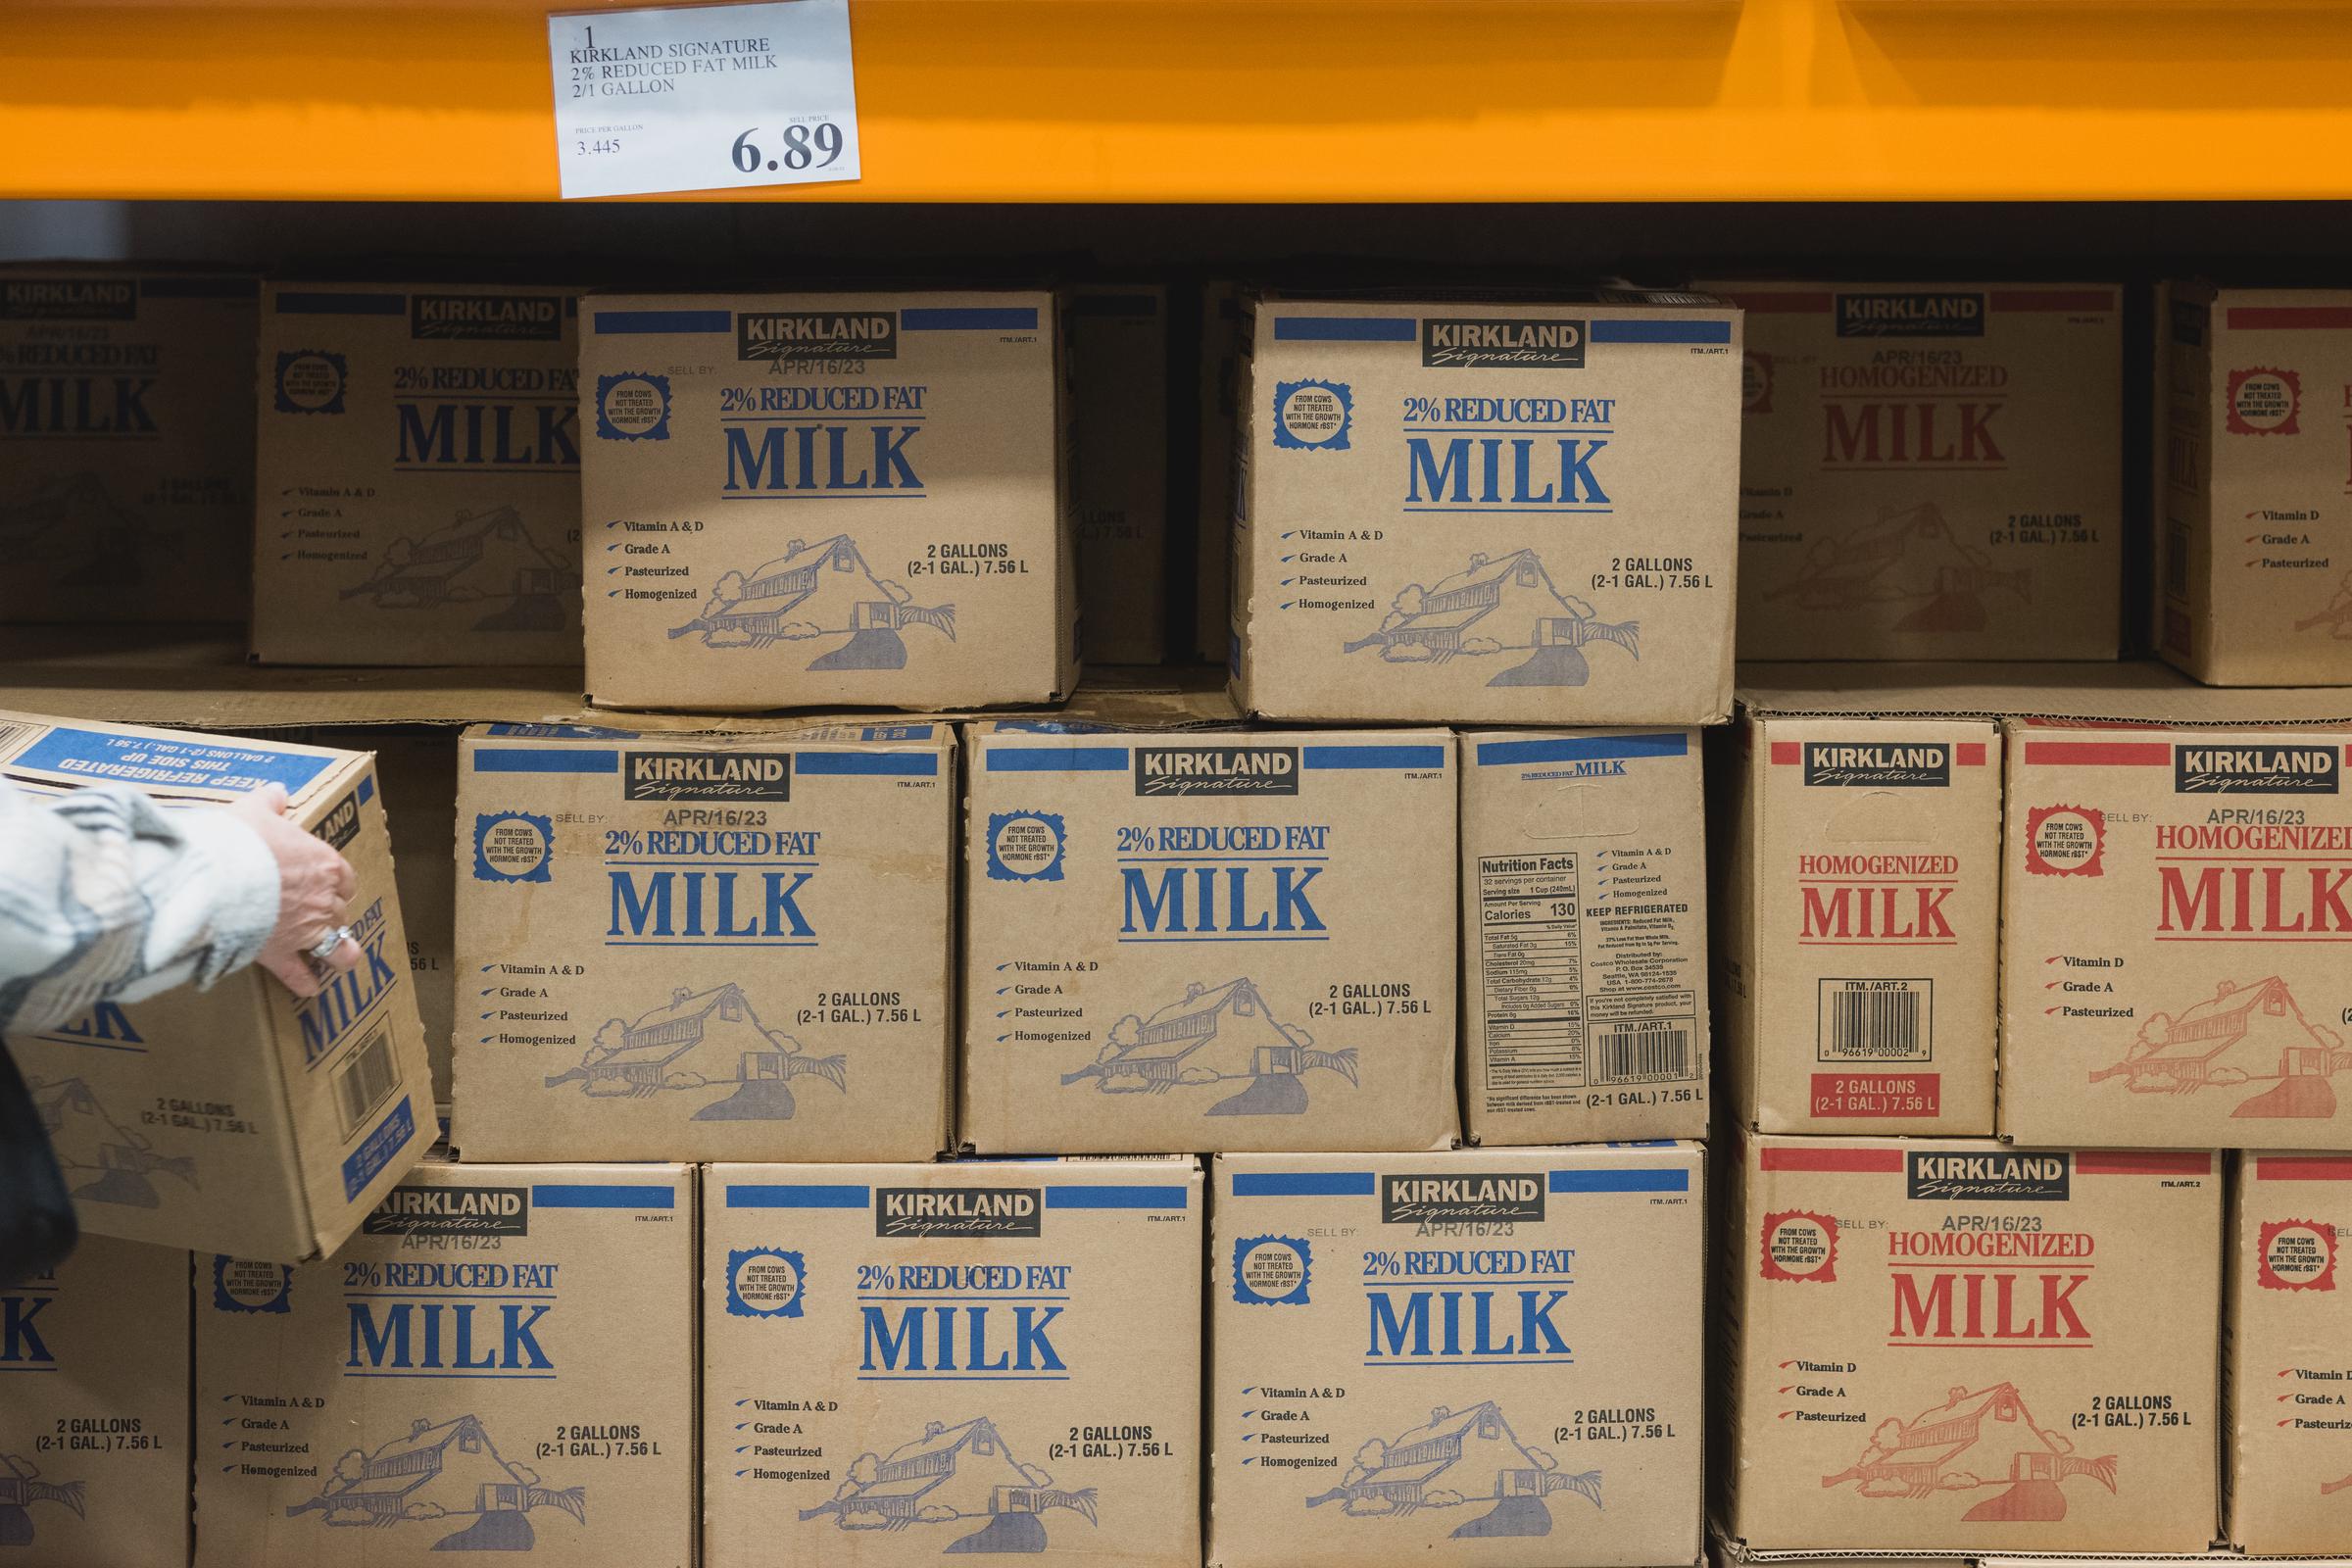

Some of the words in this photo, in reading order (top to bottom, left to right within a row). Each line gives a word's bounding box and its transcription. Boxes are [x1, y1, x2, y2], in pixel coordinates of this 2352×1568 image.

[585, 26, 595, 48] 1
[570, 45, 662, 64] KIRKLAND
[668, 38, 770, 58] SIGNATURE
[571, 67, 595, 81] 2%
[602, 60, 687, 79] REDUCED
[693, 57, 726, 74] FAT
[732, 54, 778, 71] MILK
[572, 83, 595, 98] 2/1
[602, 78, 675, 96] GALLON
[612, 123, 644, 132] GALLON
[577, 139, 620, 156] 3.445
[732, 122, 843, 172] 6.89
[747, 318, 889, 339] KIRKLAND
[1432, 324, 1579, 349] KIRKLAND
[748, 340, 891, 360] Signature
[1432, 347, 1579, 369] Signature
[768, 359, 866, 376] APR/16/23
[1820, 367, 2008, 389] HOMOGENIZED
[721, 387, 756, 411] 2%
[760, 387, 878, 412] REDUCED
[884, 386, 927, 410] FAT
[1403, 398, 1441, 422] 2%
[1445, 398, 1566, 424] REDUCED
[1571, 399, 1615, 423] FAT
[1823, 404, 2006, 463] MILK
[723, 426, 924, 491] MILK
[1404, 437, 1611, 506] MILK
[121, 752, 147, 764] UP
[149, 756, 189, 770] SIDE
[189, 759, 232, 772] THIS
[1145, 754, 1292, 775] KIRKLAND
[1813, 747, 1943, 768] KIRKLAND
[2184, 751, 2332, 773] KIRKLAND
[58, 759, 209, 785] REFRIGERATED
[634, 758, 783, 781] KIRKLAND
[1575, 760, 1626, 776] MILK
[1813, 767, 1943, 786] Signature
[634, 781, 784, 803] Signature
[1145, 776, 1293, 796] Signature
[2184, 772, 2332, 793] Signature
[556, 814, 585, 824] SELL
[663, 809, 767, 826] APR/16/23
[606, 830, 643, 855] 2%
[647, 830, 770, 857] REDUCED
[775, 831, 820, 856] FAT
[1117, 827, 1153, 852] 2%
[1158, 827, 1280, 852] REDUCED
[1286, 826, 1330, 850] FAT
[2156, 825, 2352, 850] HOMOGENIZE
[1612, 849, 1644, 858] Vitamin
[1646, 848, 1653, 857] A
[1482, 859, 1537, 873] Nutrition
[1540, 858, 1574, 870] Facts
[1612, 862, 1639, 871] Grade
[1799, 855, 1958, 874] HOMOGENIZED
[1494, 878, 1522, 887] servings
[1612, 875, 1661, 885] Pasteurized
[1119, 867, 1326, 933] MILK
[1483, 888, 1507, 897] Serving
[1613, 888, 1668, 899] Homogenized
[2157, 867, 2352, 932] MILK
[607, 869, 816, 939] MILK
[1485, 909, 1531, 921] Calories
[1550, 903, 1576, 916] 130
[1587, 906, 1612, 917] KEEP
[1615, 904, 1689, 915] REFRIGERATED
[1800, 888, 1955, 938] MILK
[1014, 961, 1060, 972] Vitamin
[1063, 961, 1072, 972] A
[1076, 961, 1086, 972] &
[1090, 961, 1099, 972] D
[1015, 984, 1052, 996] Grade
[1054, 984, 1063, 995] A
[1329, 984, 1338, 999] 2
[1343, 984, 1410, 999] GALLONS
[1844, 981, 1908, 992] ITM./ART.2
[1015, 1007, 1083, 1018] Pasteurized
[1308, 1001, 1337, 1017] (2-1
[1341, 1001, 1383, 1017] GAL.)
[1387, 1001, 1420, 1014] 7.56
[1423, 1000, 1431, 1013] L
[1014, 1031, 1091, 1044] Homogenized
[1614, 1022, 1672, 1033] ITM./ART.1
[1842, 1048, 1873, 1057] 96619
[1878, 1048, 1909, 1057] 00002
[1836, 1080, 1845, 1094] 2
[1848, 1080, 1916, 1094] GALLONS
[1586, 1094, 1613, 1109] (2-1
[1618, 1091, 1657, 1106] GAL.)
[1661, 1090, 1691, 1102] 7.56
[1695, 1089, 1703, 1101] L
[1815, 1097, 1843, 1113] (2-1
[1845, 1097, 1887, 1113] GAL.)
[1891, 1097, 1924, 1110] 7.56
[1928, 1097, 1936, 1110] L
[1917, 1157, 2063, 1181] KIRKLAND
[1392, 1180, 1538, 1202] KIRKLAND
[1917, 1180, 2063, 1200] Signature
[1392, 1202, 1539, 1223] Signature
[1835, 1219, 1865, 1229] SELL
[1868, 1220, 1888, 1230] BY:
[1941, 1215, 2043, 1233] APR/16/23
[401, 1235, 502, 1250] APR/16/23
[1888, 1232, 2094, 1257] HOMOGENIZED
[1363, 1251, 1400, 1276] 2%
[1404, 1250, 1526, 1275] REDUCED
[1531, 1250, 1575, 1274] FAT
[1889, 1273, 2091, 1339] MILK
[1365, 1291, 1572, 1356] MILK
[346, 1301, 555, 1372] MILK
[858, 1305, 1067, 1372] MILK
[1796, 1360, 1844, 1373] Vitamin
[1846, 1361, 1857, 1373] D
[1795, 1386, 1835, 1397] Grade
[1837, 1386, 1846, 1398] A
[1795, 1410, 1867, 1423] Pasteurized
